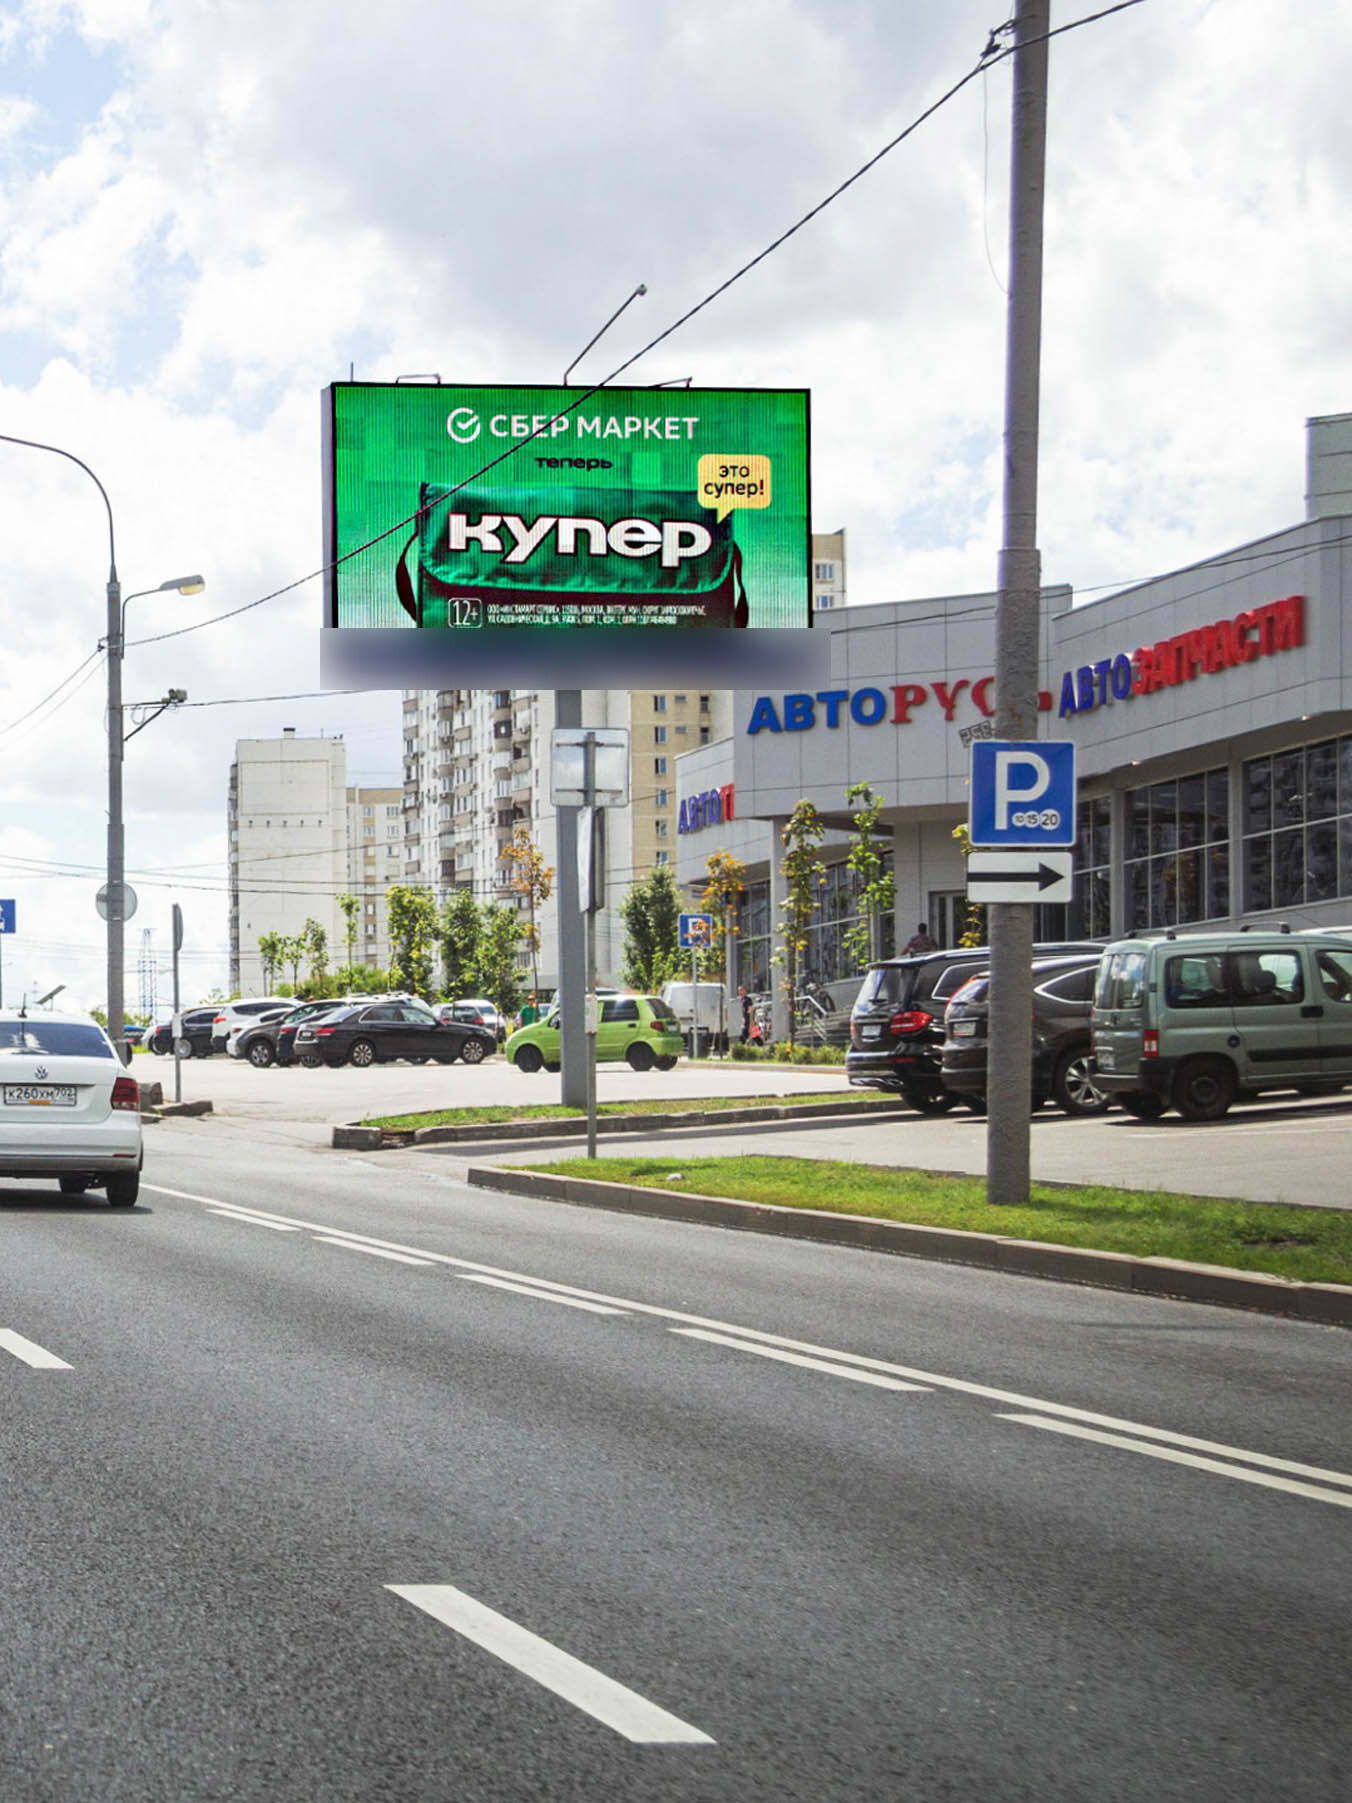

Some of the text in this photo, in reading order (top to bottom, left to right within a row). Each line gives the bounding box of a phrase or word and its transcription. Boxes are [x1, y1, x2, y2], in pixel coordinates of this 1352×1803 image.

[490, 414, 699, 439] СБЕР МАРКЕТ
[534, 456, 613, 471] теперь
[718, 465, 750, 478] это
[703, 479, 765, 499] супер!
[448, 512, 713, 568] купер
[451, 600, 480, 626] 12+
[1058, 595, 1306, 719] АВТОЗАПЧАСТИ
[1042, 814, 1058, 826] 20
